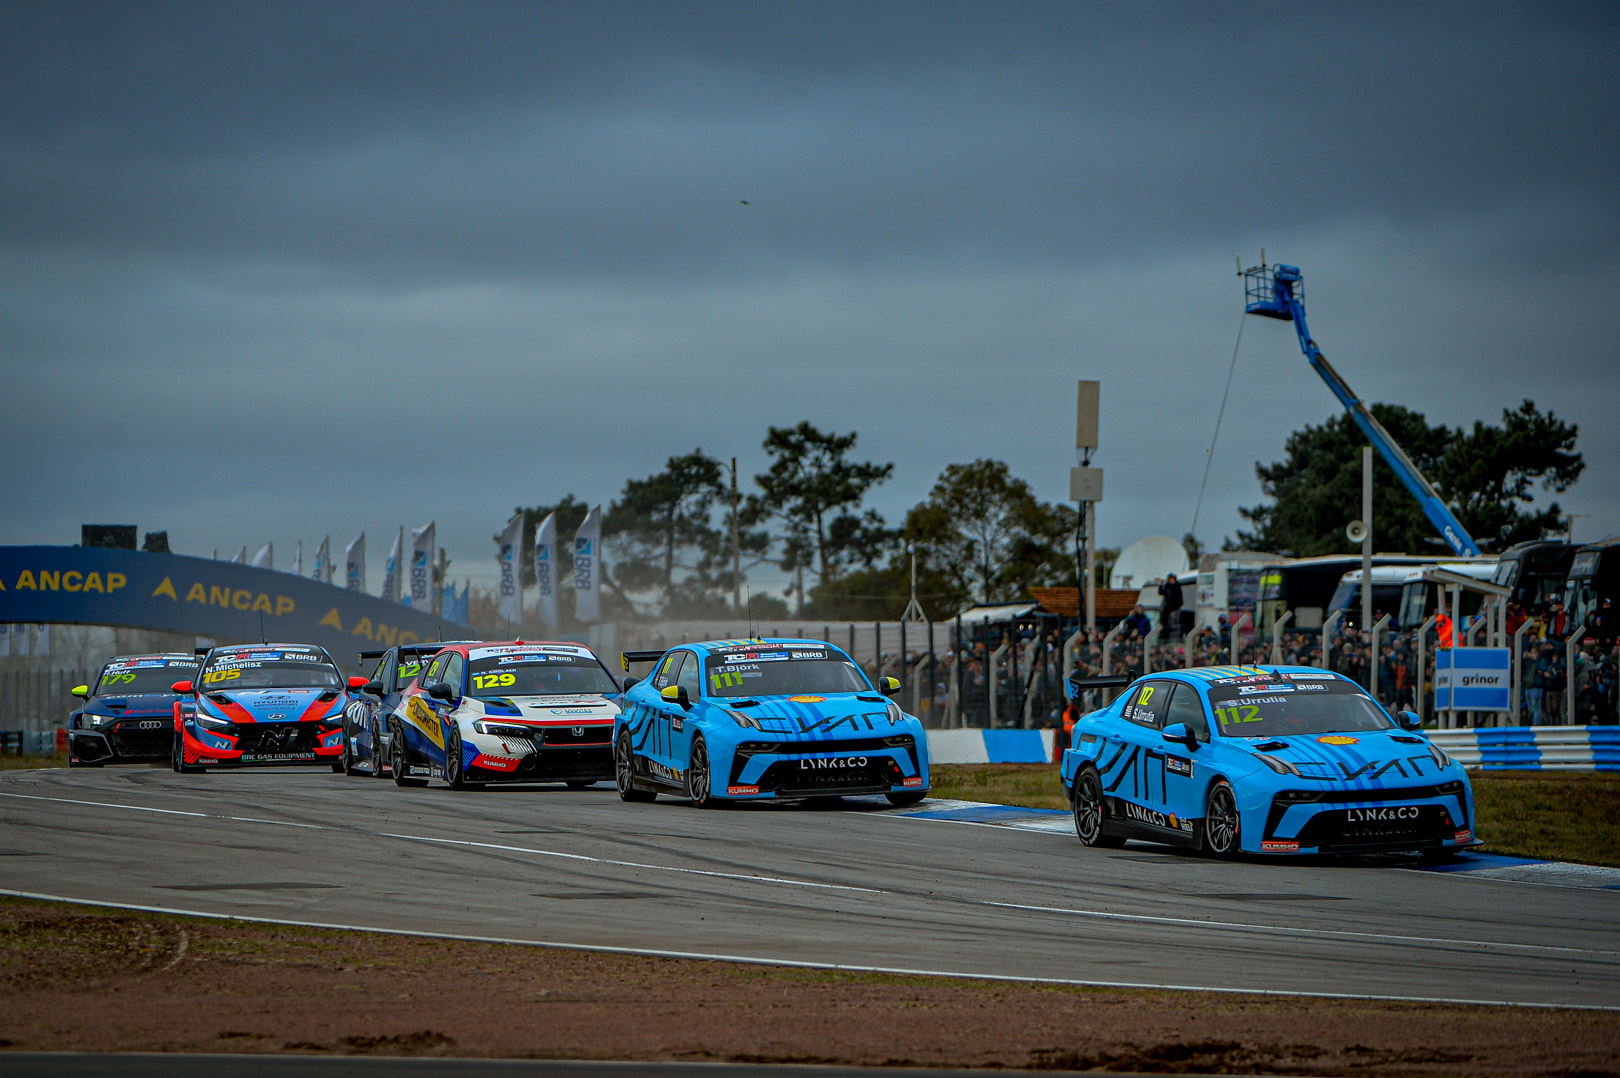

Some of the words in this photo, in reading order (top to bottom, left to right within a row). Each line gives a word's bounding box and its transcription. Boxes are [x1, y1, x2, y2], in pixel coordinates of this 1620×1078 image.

[500, 561, 515, 596] BRB
[536, 561, 552, 596] BRB
[575, 556, 592, 591] BRB
[15, 569, 127, 594] ANCAP
[411, 567, 427, 600] BRB
[185, 582, 296, 617] ANCAP
[351, 616, 436, 646] ANC
[216, 653, 250, 663] TCR
[296, 654, 317, 662] BRB
[498, 655, 523, 663] TCR
[724, 652, 759, 661] TCR
[803, 651, 823, 659] BRB
[107, 661, 137, 669] TCR
[204, 662, 262, 674] N.Michelisz
[715, 663, 760, 673] T.Björk
[101, 673, 137, 686] 179
[203, 668, 241, 684] 105
[473, 673, 516, 690] 129
[710, 671, 744, 689] 111
[1462, 673, 1500, 686] grinor
[1238, 684, 1268, 692] TCR
[1137, 686, 1155, 706] 112
[1227, 696, 1287, 707] S.Urrutia
[1132, 708, 1155, 723] S.Urrutia
[1214, 705, 1263, 726] 112
[483, 760, 507, 768] KUMHO
[800, 756, 868, 770] LYNK&CO
[1347, 807, 1419, 822] LYNK&CO
[1262, 843, 1299, 851] KUMHO
